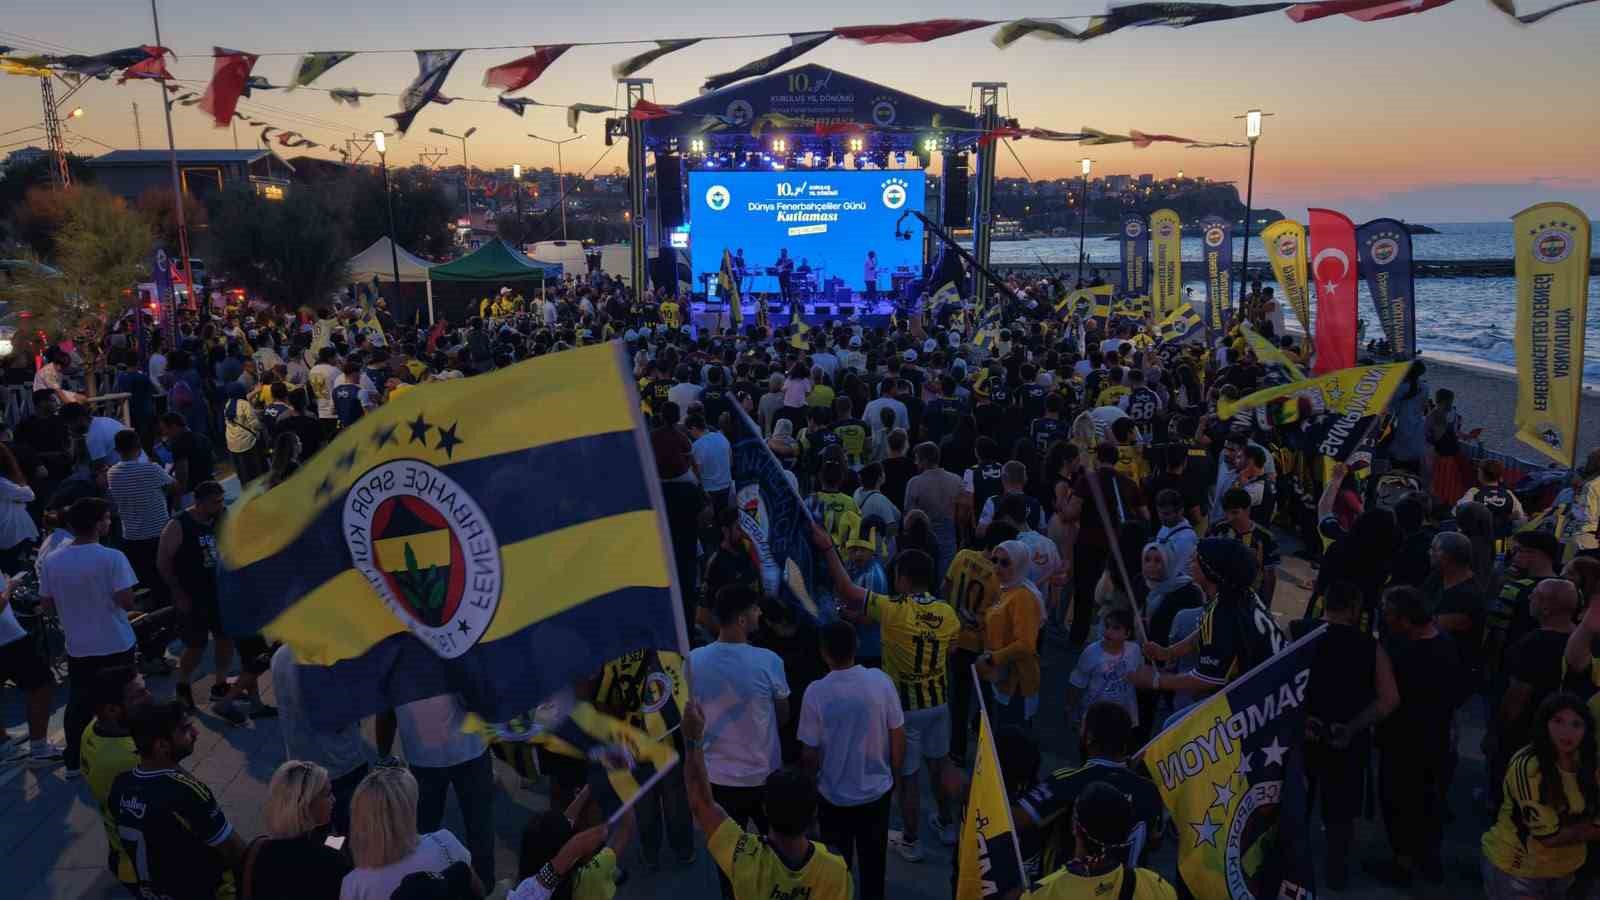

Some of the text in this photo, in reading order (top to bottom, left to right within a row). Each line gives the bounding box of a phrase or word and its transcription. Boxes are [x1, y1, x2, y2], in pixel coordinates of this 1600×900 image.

[748, 201, 867, 213] Dünya Fenerbahçeliler Günü
[776, 210, 839, 222] Kutlaması
